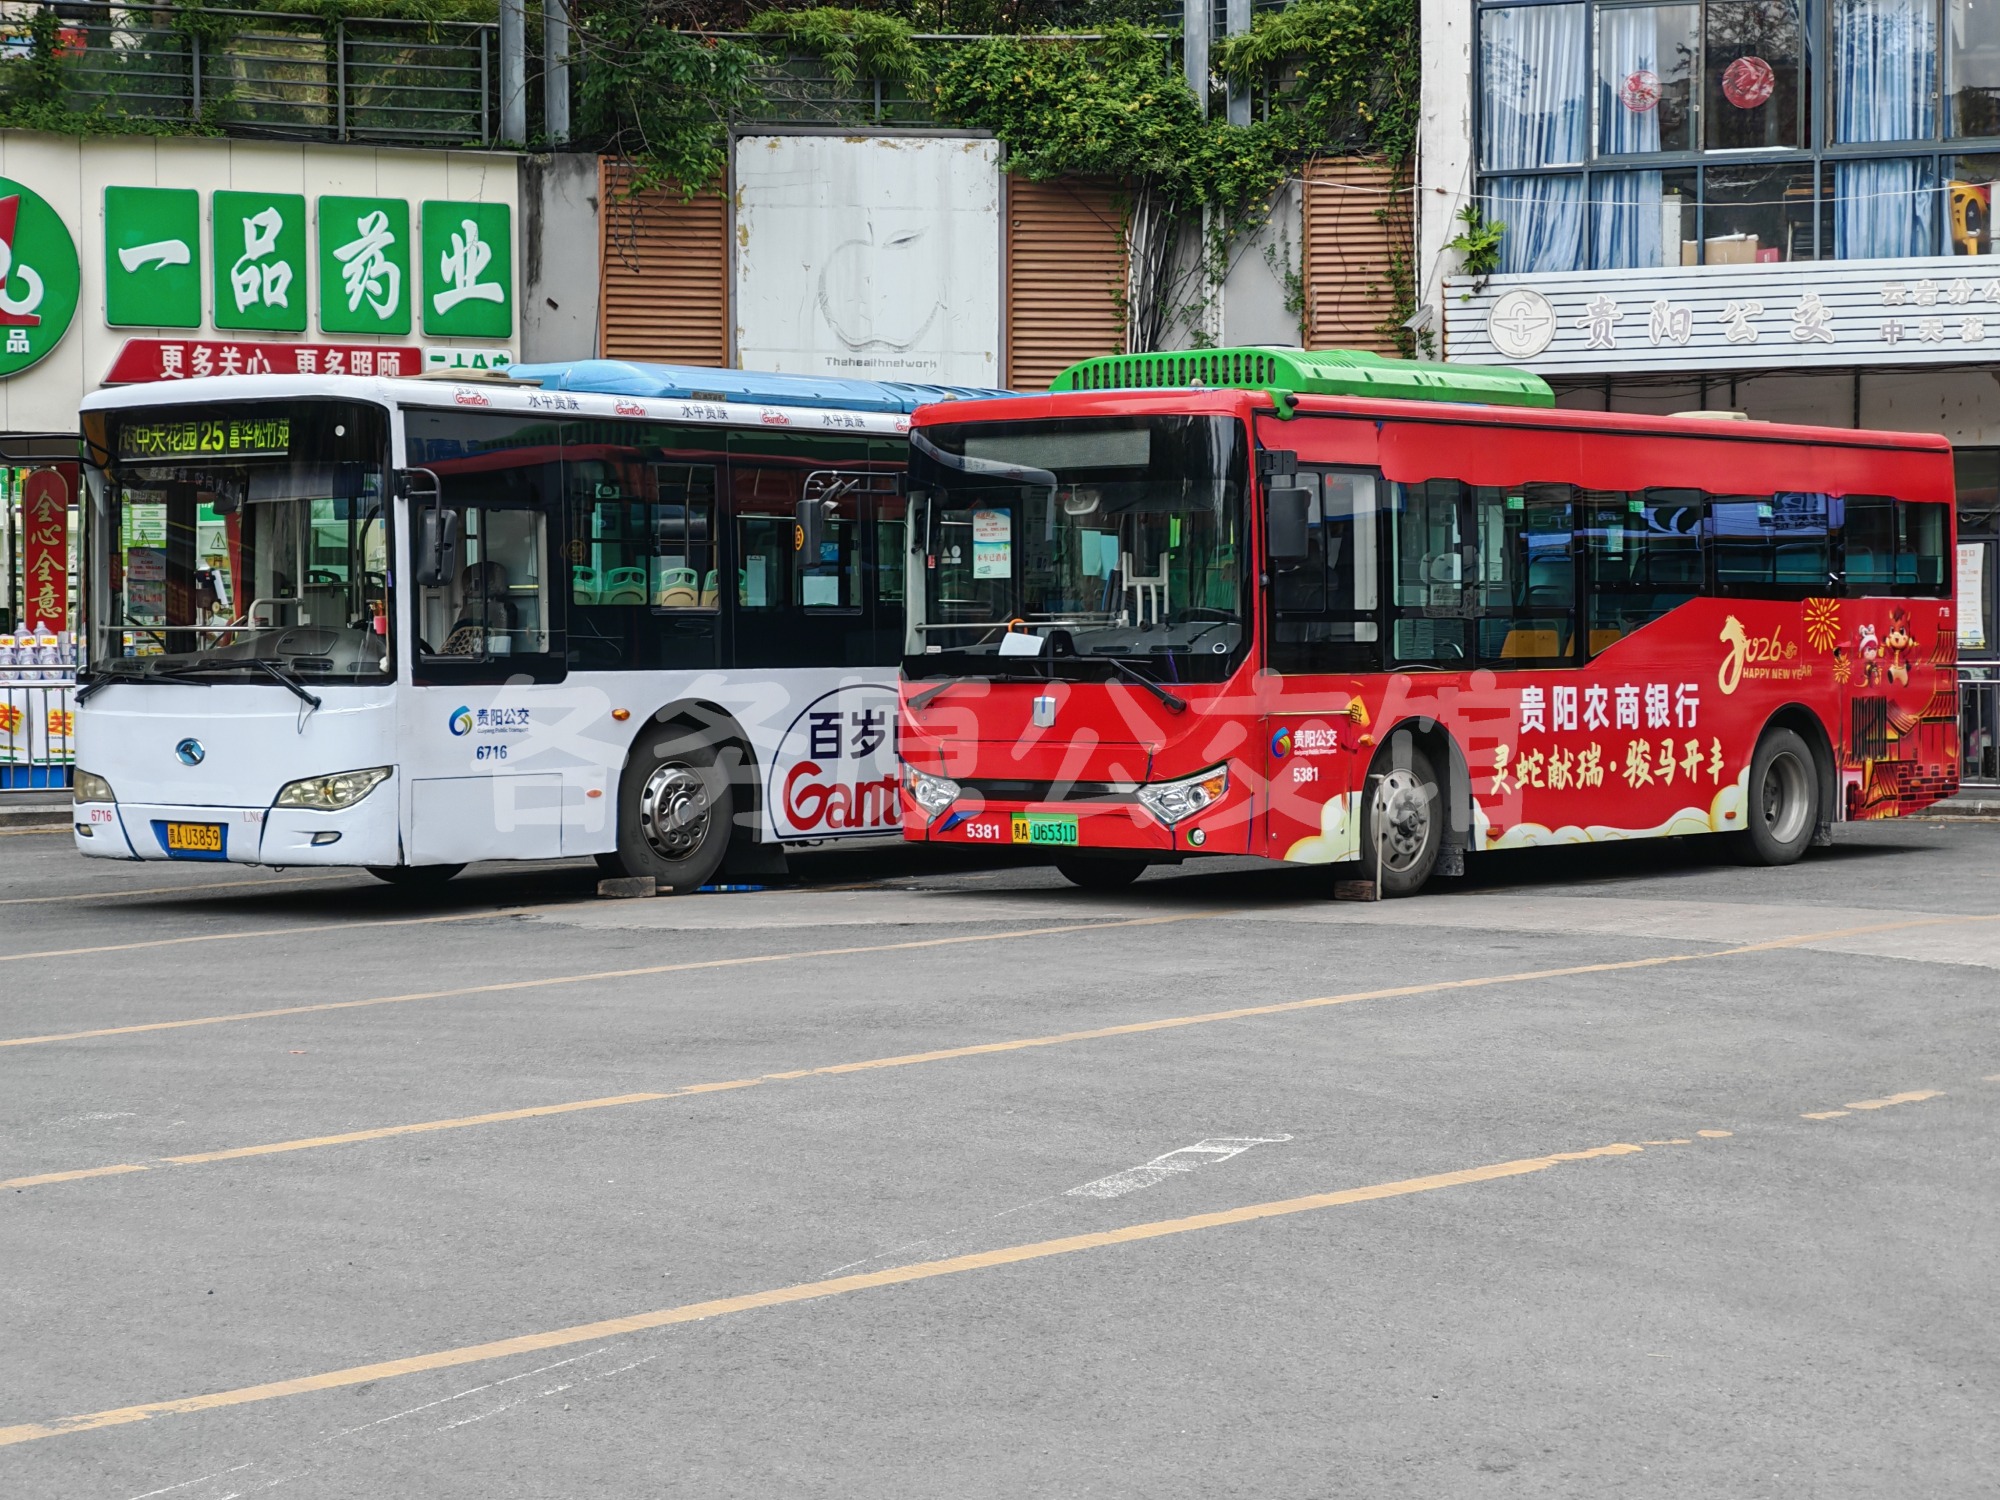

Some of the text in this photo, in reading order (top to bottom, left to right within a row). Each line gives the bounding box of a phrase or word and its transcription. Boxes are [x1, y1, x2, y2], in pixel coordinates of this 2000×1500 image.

[119, 207, 504, 320] 一品药业
[1576, 293, 1835, 349] 贵阳公交
[7, 329, 30, 353] 品
[160, 344, 400, 378] 更多关心 更多照顾
[528, 393, 580, 410] 水中贵族
[681, 404, 729, 420] 水中贵族
[822, 412, 866, 428] 水中贵族
[136, 422, 198, 452] 中天花园
[201, 420, 225, 450] 25
[229, 418, 290, 449] 富华松竹苑
[29, 489, 65, 619] 全心全意
[1743, 665, 1813, 680] HAPPY NEW YEAR
[477, 707, 529, 726] 贵阳公交
[1519, 682, 1700, 734] 贵阳农商银行
[809, 709, 900, 760] 百岁
[1294, 729, 1337, 748] 贵阳公交
[476, 745, 508, 760] 6716
[1293, 766, 1319, 782] 5381
[783, 761, 903, 831] Gant
[91, 809, 112, 822] 6716
[243, 810, 263, 823] LNG
[966, 823, 1000, 839] 5381
